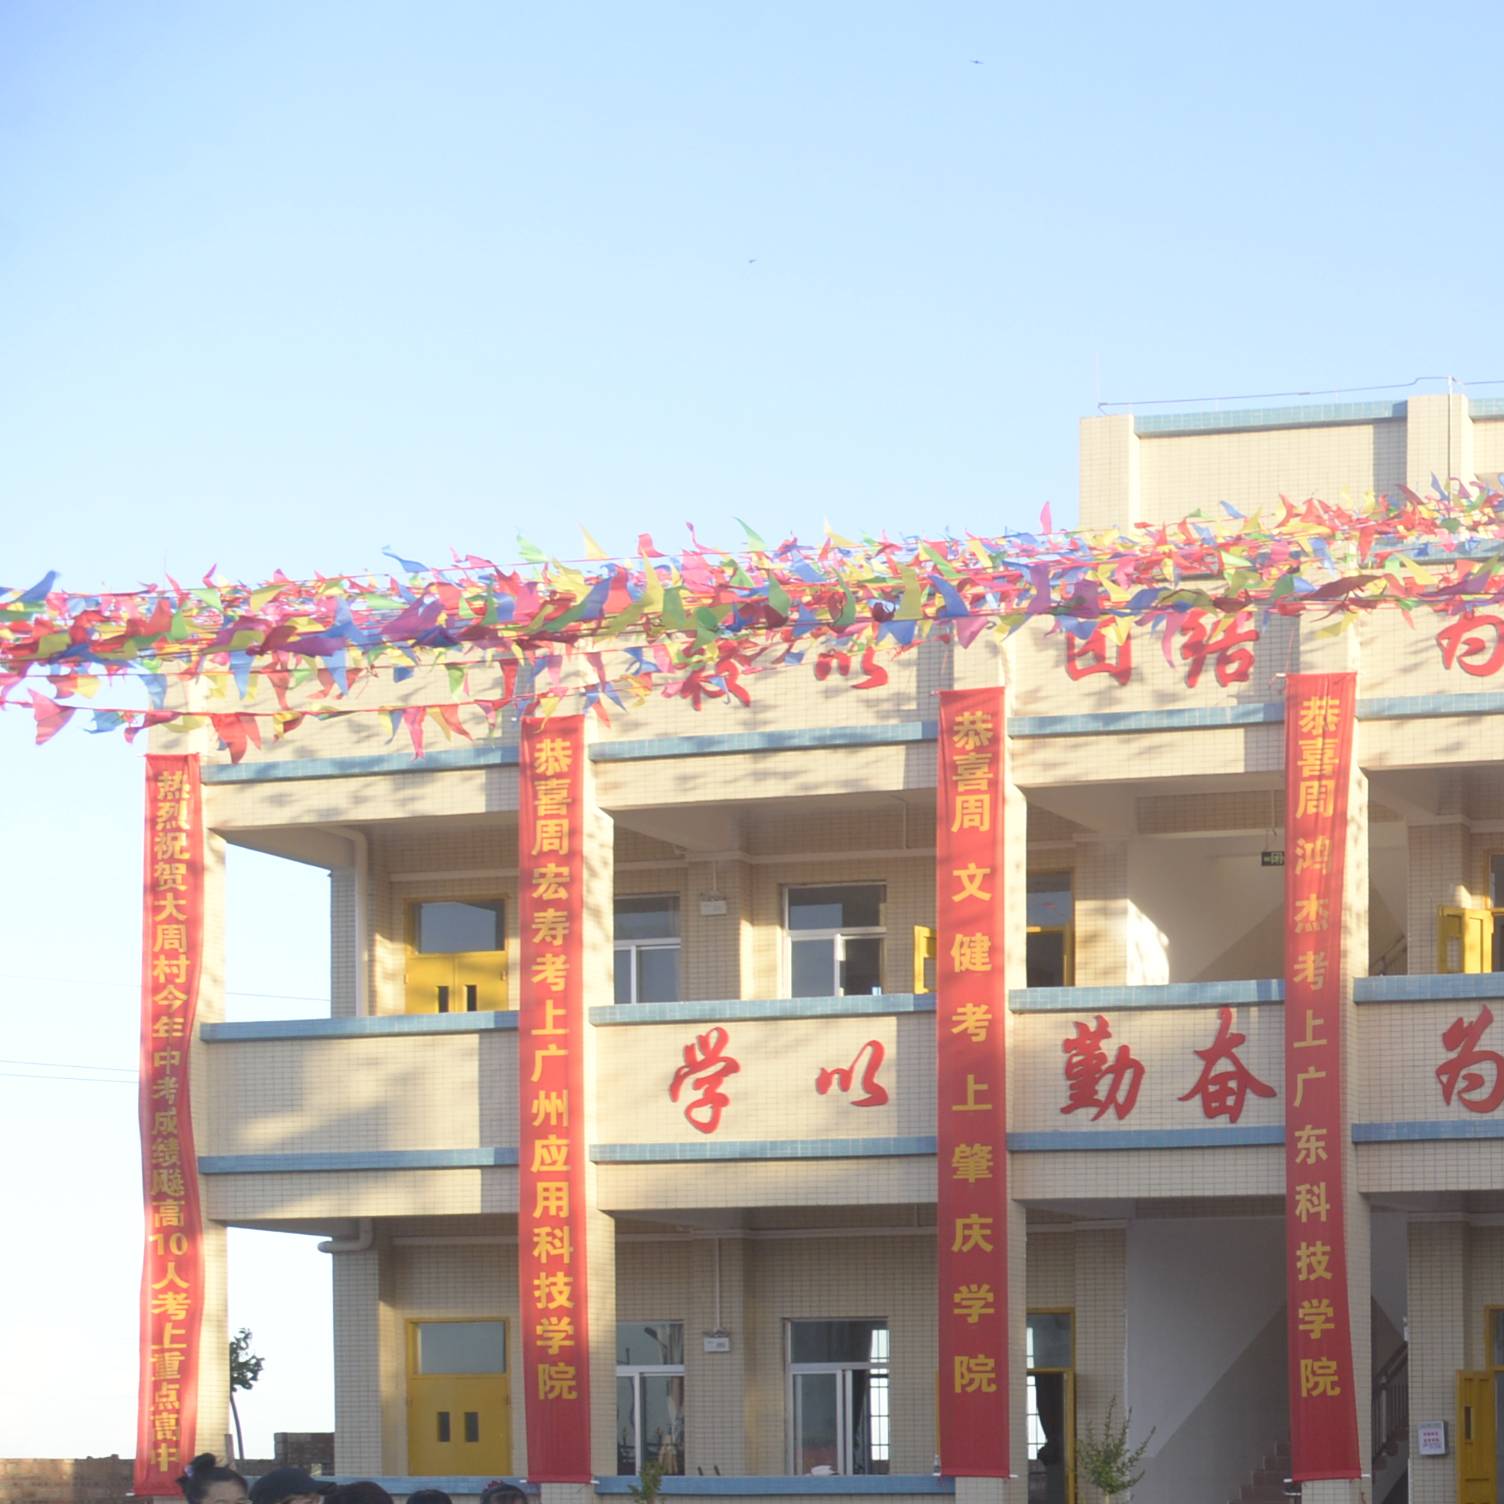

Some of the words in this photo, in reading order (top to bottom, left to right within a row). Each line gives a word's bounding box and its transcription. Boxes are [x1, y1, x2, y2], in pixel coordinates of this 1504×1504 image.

[530, 739, 578, 1400] 恭喜周宏寿考上广州应用科技学院
[950, 711, 998, 1394] 恭喜周文健考上肇庆学院
